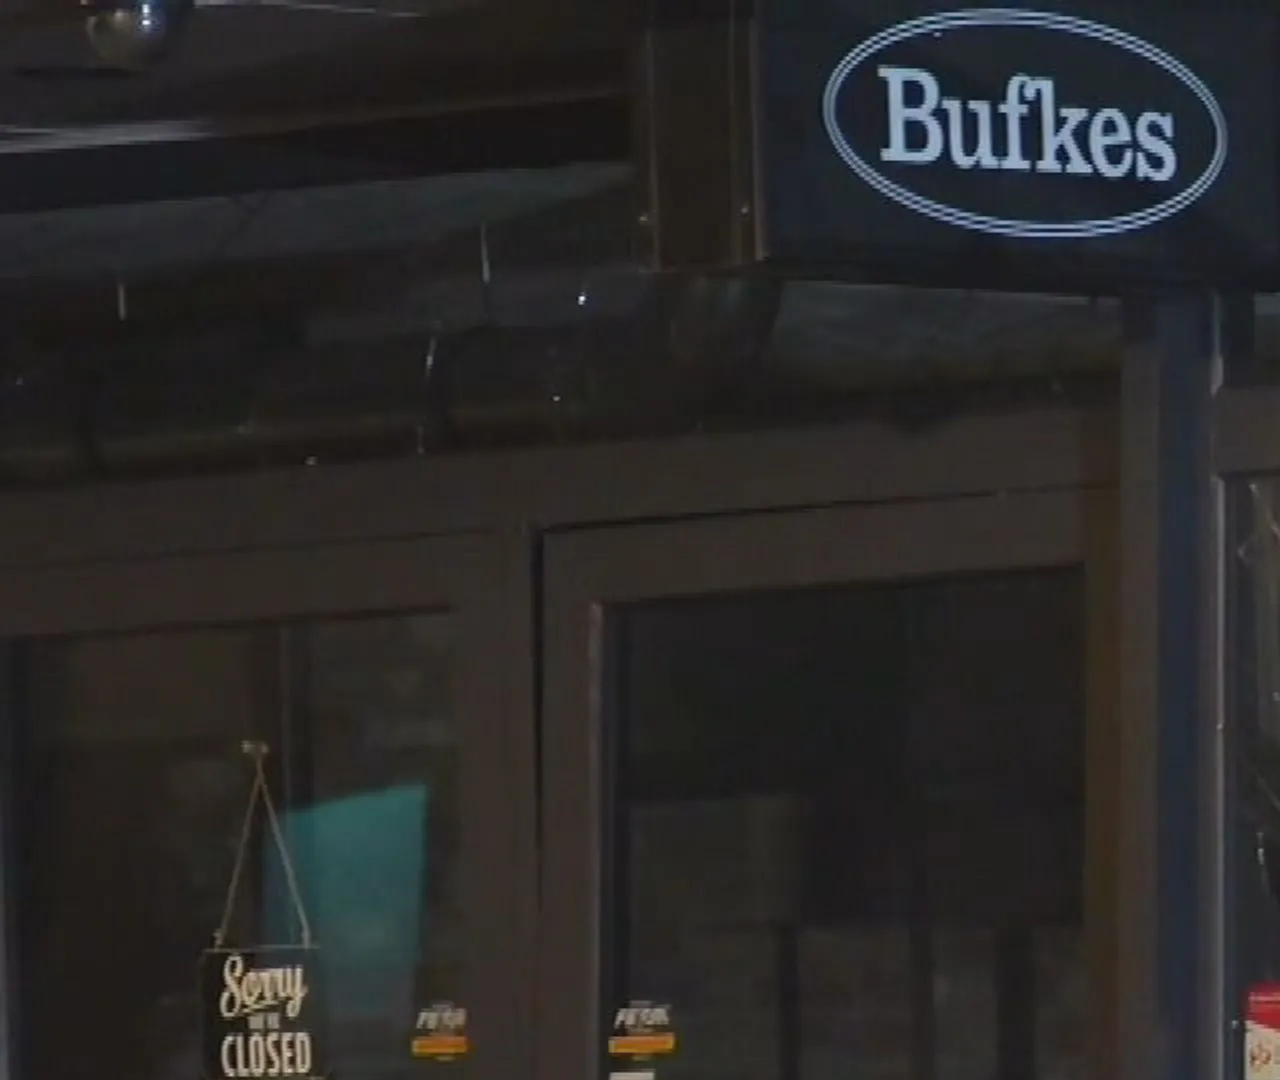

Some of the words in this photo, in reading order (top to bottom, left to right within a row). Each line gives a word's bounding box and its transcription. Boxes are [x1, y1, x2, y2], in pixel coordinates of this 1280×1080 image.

[876, 65, 1179, 183] Bufkes
[218, 954, 309, 1019] Sorry
[220, 1031, 313, 1078] CLOSED
